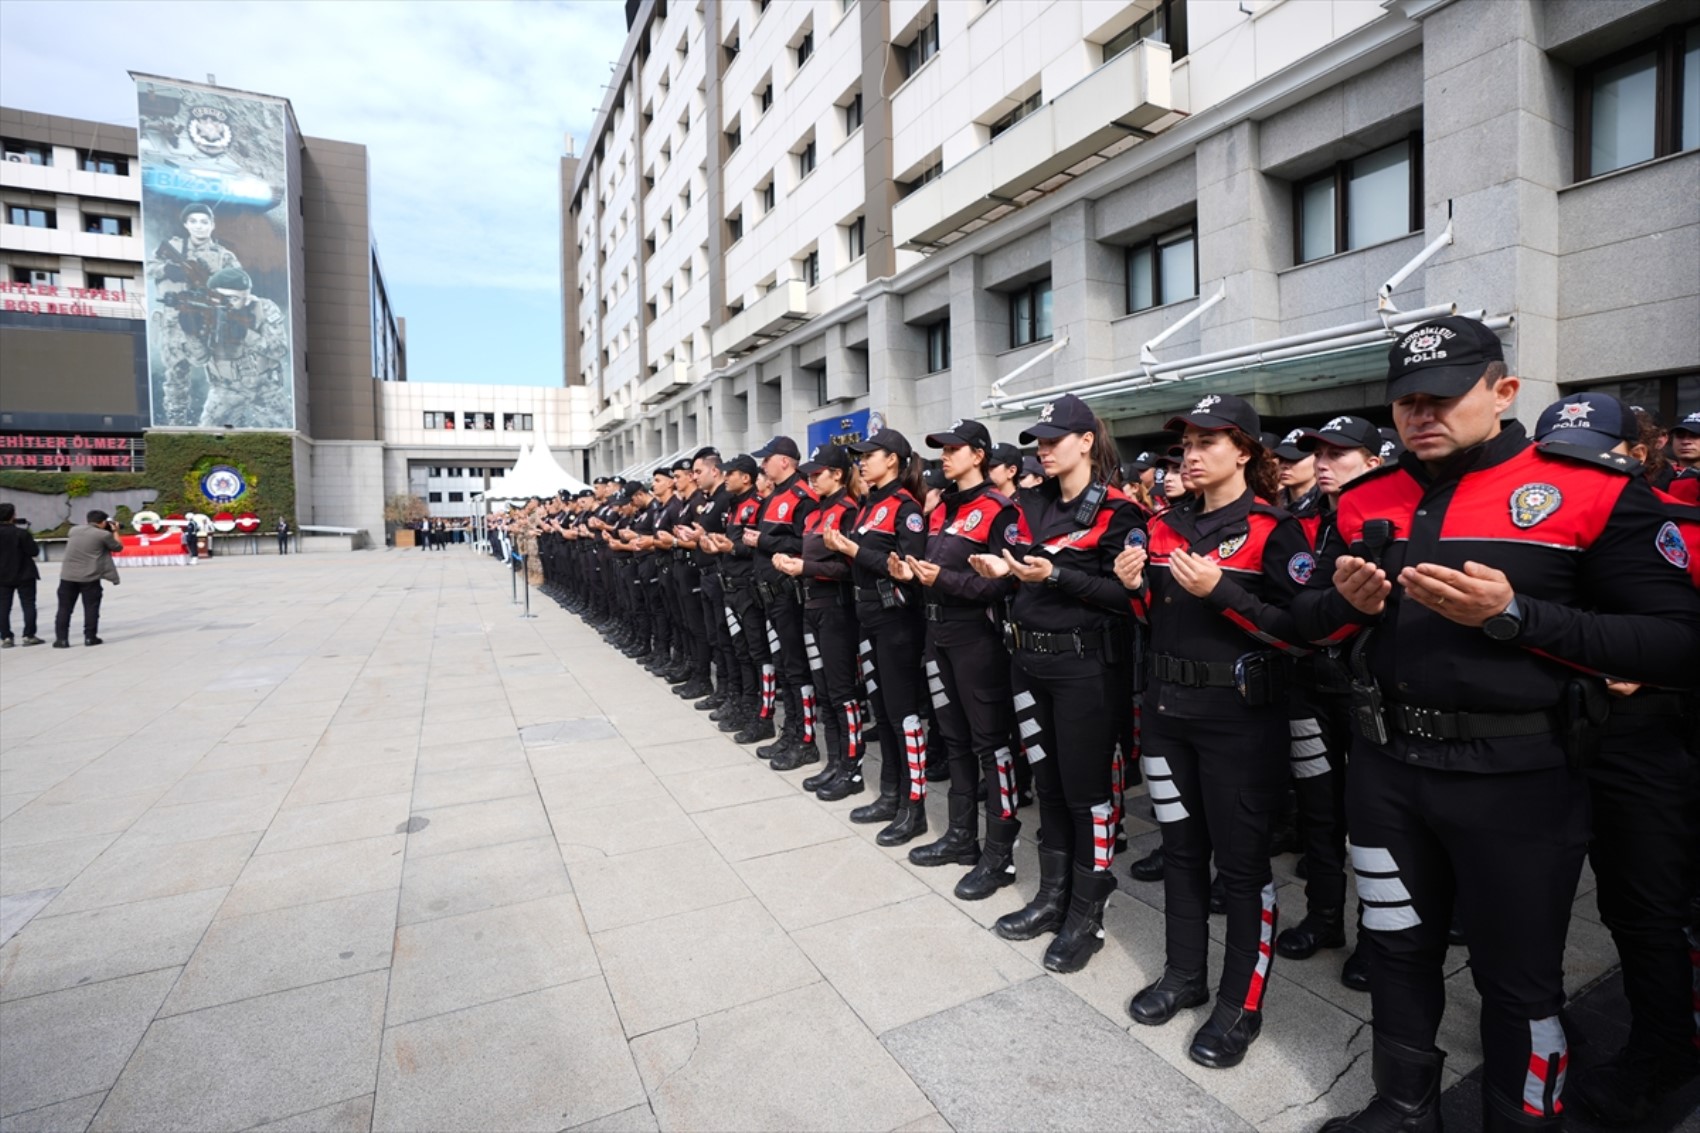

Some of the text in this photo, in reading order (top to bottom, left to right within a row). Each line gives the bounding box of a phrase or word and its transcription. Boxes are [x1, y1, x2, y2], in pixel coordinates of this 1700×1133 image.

[68, 286, 126, 302] TEPESİ
[5, 299, 97, 317] BOŞ DEĞİL
[1403, 349, 1447, 365] POLİS
[1552, 419, 1591, 430] POLİS
[72, 435, 127, 448] ÖLMEZ
[43, 452, 130, 467] BÖLÜNMEZ
